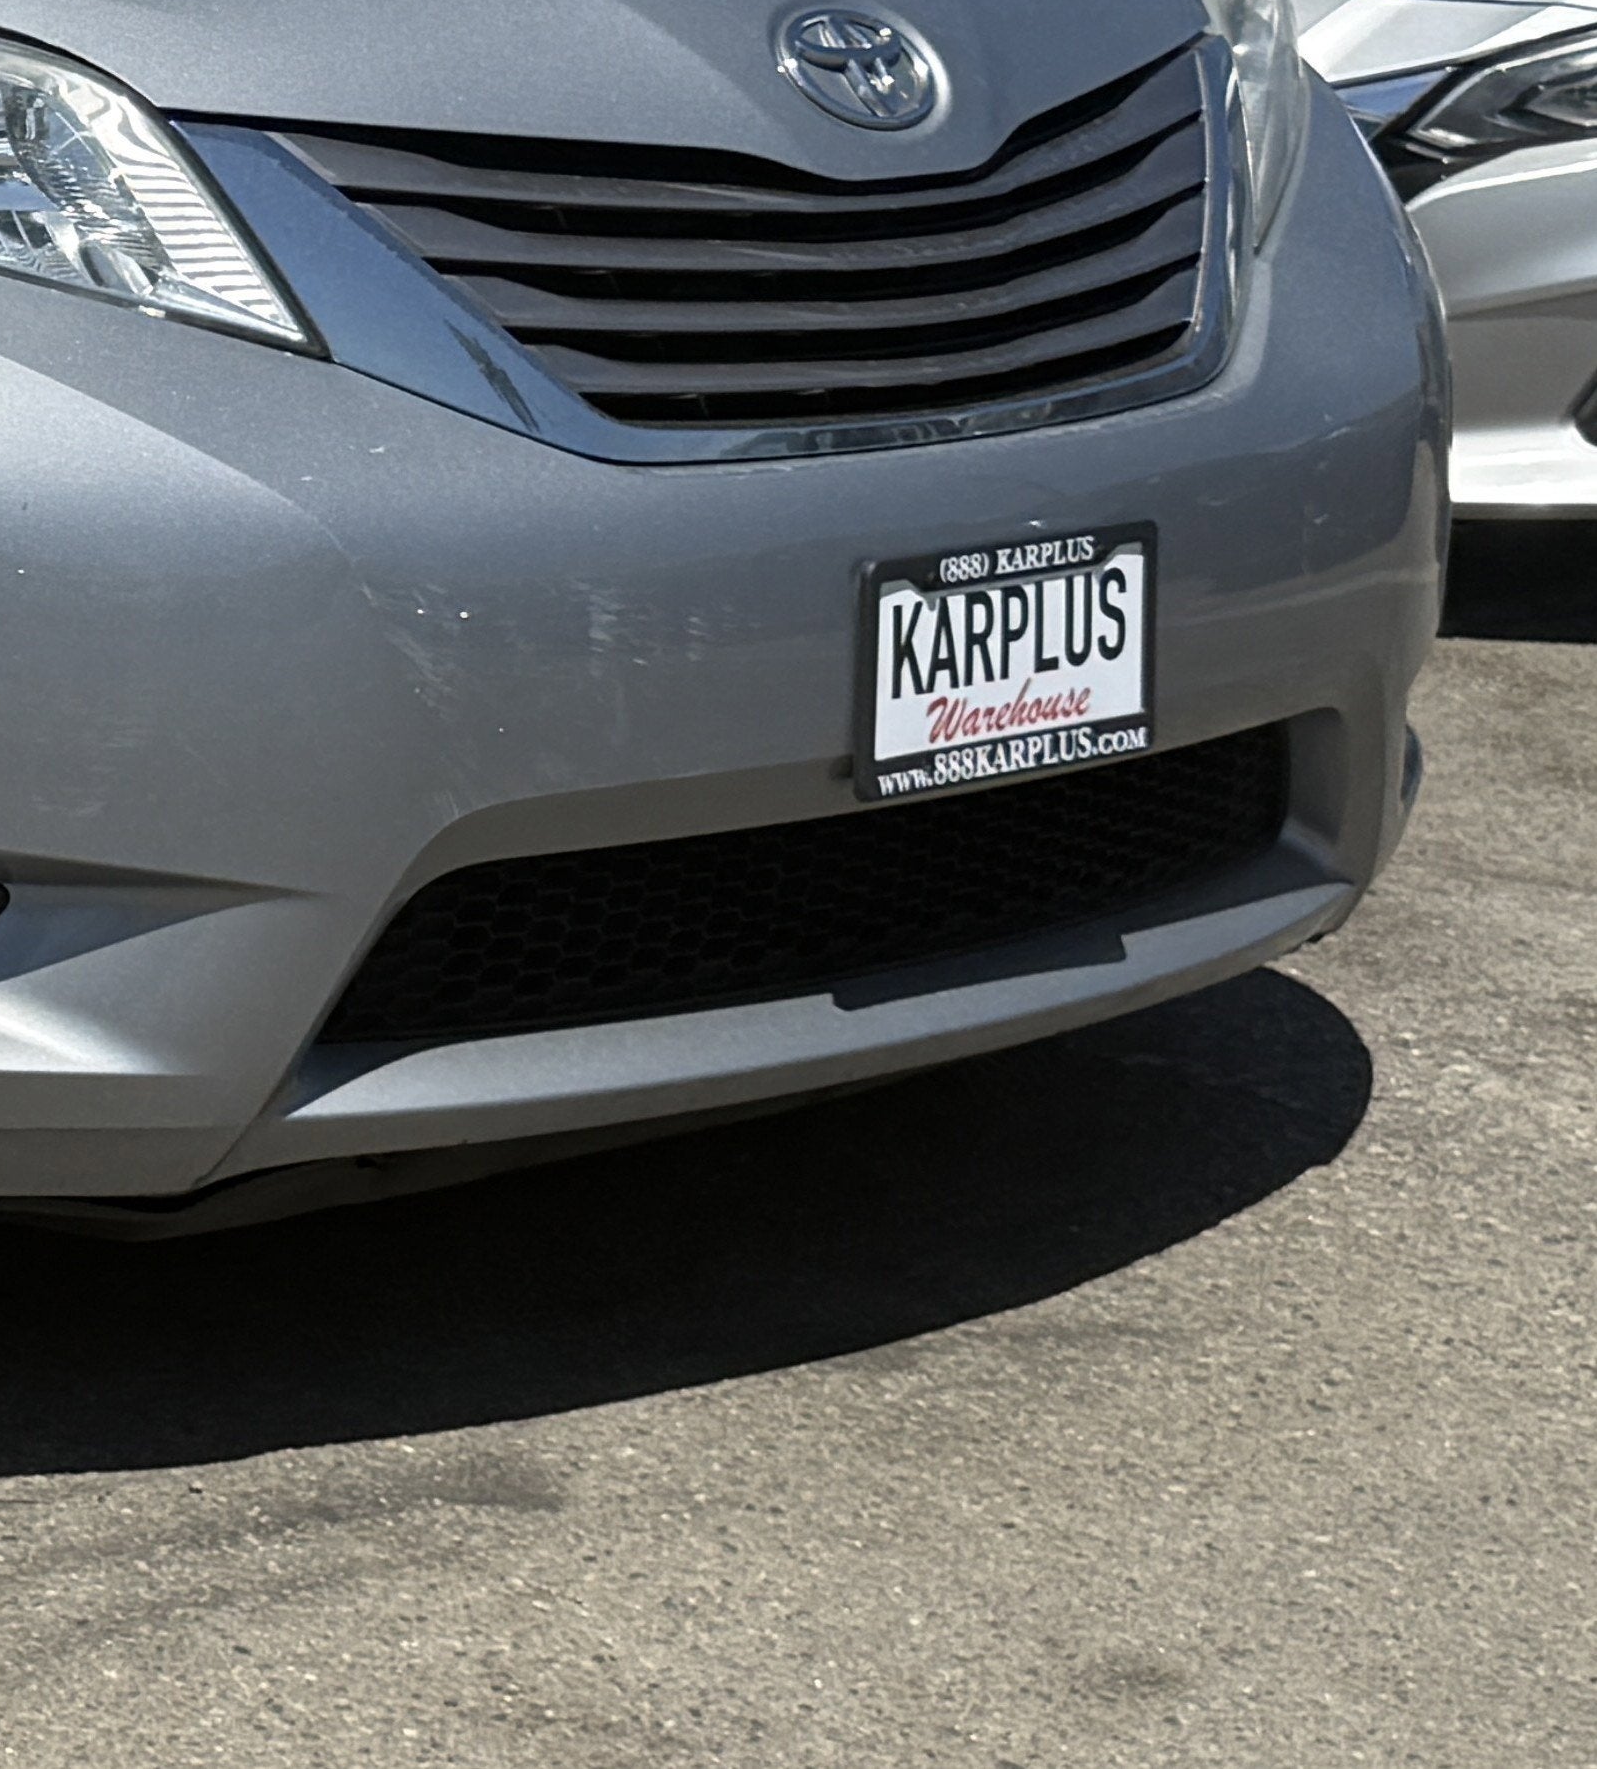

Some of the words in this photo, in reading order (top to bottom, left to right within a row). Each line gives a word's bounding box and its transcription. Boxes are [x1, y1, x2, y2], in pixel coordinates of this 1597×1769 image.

[939, 552, 990, 583] (888)
[994, 535, 1095, 575] KARPLUS
[891, 567, 1127, 699] KARPLUS
[926, 677, 1092, 744] Warehouse
